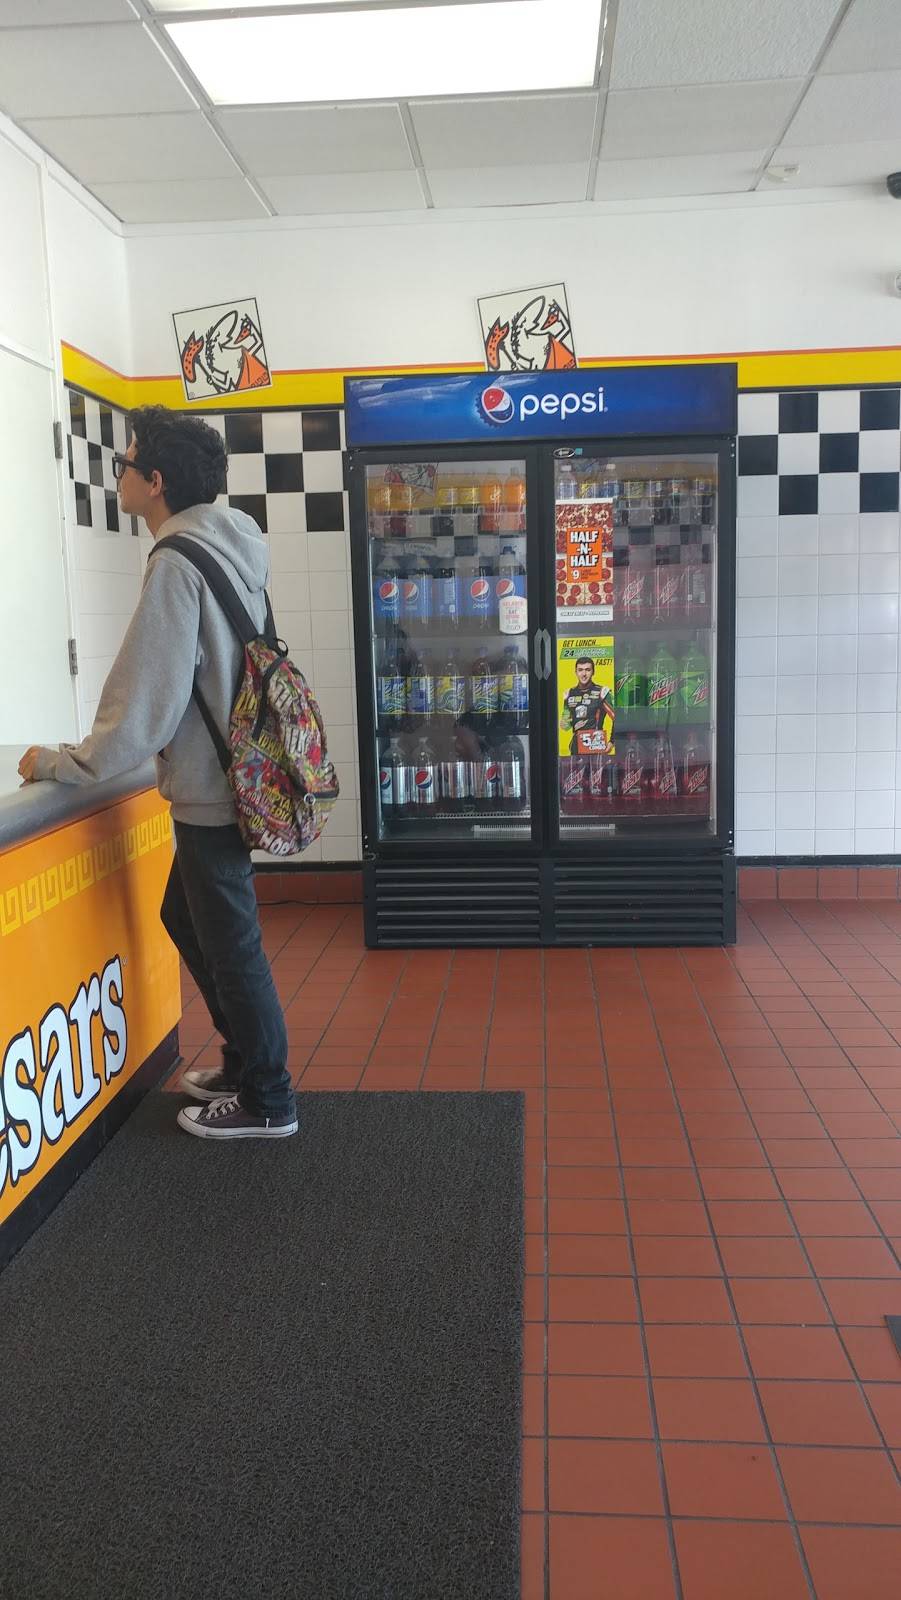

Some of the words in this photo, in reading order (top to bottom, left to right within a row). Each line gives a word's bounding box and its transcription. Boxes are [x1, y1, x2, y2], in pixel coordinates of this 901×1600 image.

[520, 386, 605, 420] pepsi
[570, 530, 599, 543] HALF
[576, 543, 592, 555] -N-
[570, 554, 599, 567] HALF
[562, 639, 575, 648] GET
